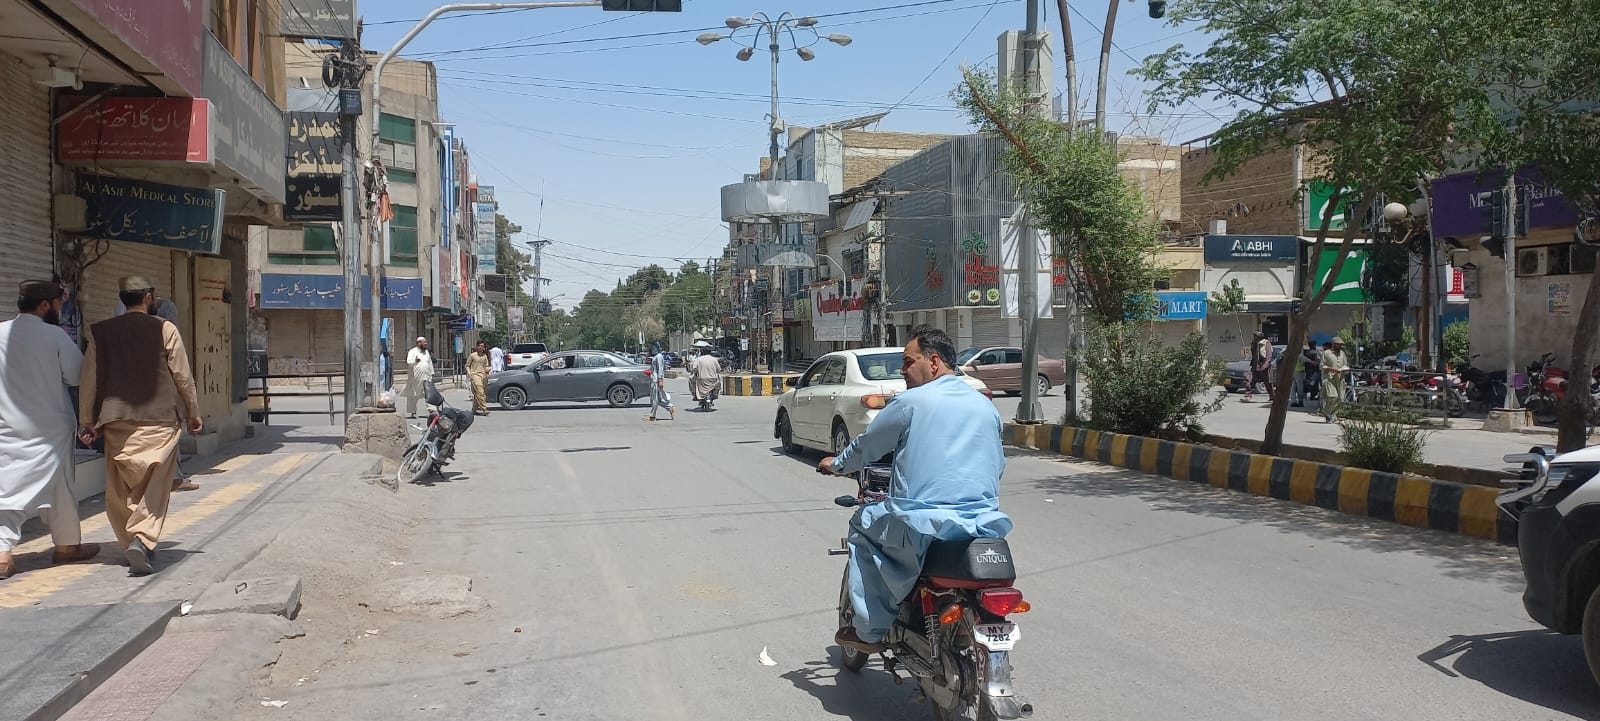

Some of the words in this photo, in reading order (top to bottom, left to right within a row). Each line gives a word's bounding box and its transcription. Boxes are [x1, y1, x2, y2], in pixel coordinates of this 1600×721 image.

[130, 186, 178, 205] MEDICAL
[183, 192, 217, 209] STORE
[1171, 300, 1203, 313] MART
[976, 555, 1008, 564] UNIQUE
[987, 626, 1004, 634] MY
